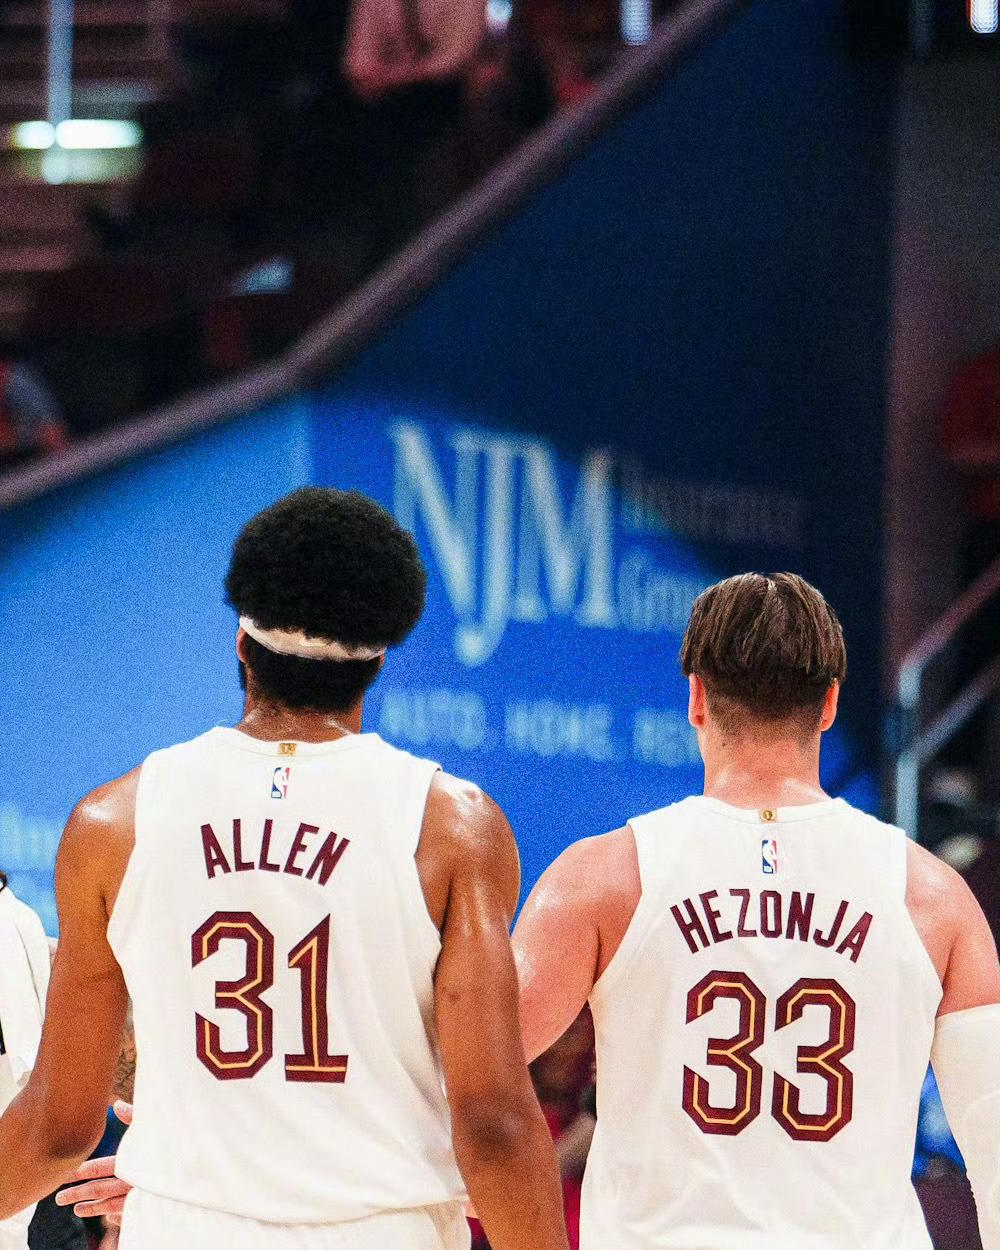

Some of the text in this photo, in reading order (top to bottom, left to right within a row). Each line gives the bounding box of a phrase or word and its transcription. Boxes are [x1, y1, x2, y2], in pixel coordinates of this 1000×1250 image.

[392, 421, 617, 666] NJM
[201, 818, 350, 886] ALLEN
[670, 888, 873, 964] HEZONJA
[191, 910, 349, 1084] 31
[682, 969, 857, 1143] 33
